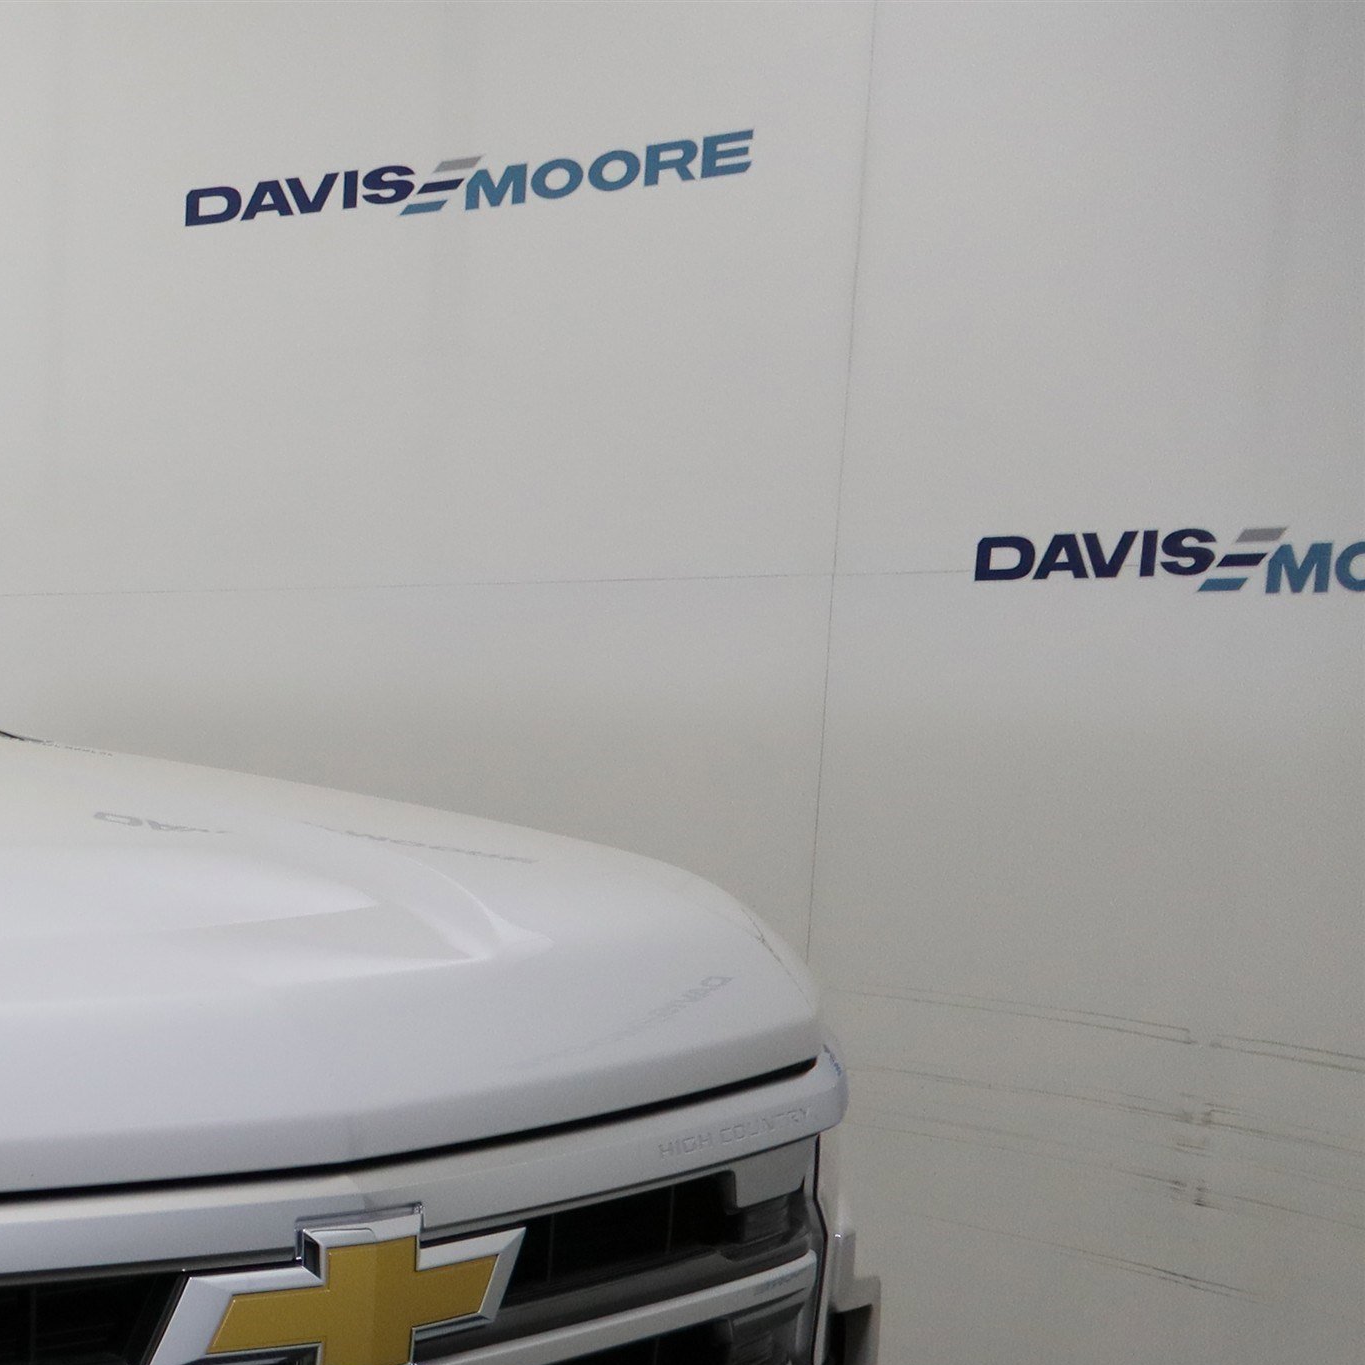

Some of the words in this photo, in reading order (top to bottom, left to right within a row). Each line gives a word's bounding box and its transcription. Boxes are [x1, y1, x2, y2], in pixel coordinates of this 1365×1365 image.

[185, 165, 415, 227] DAVIS
[465, 129, 754, 211] MOORE
[974, 528, 1217, 581] DAVIS
